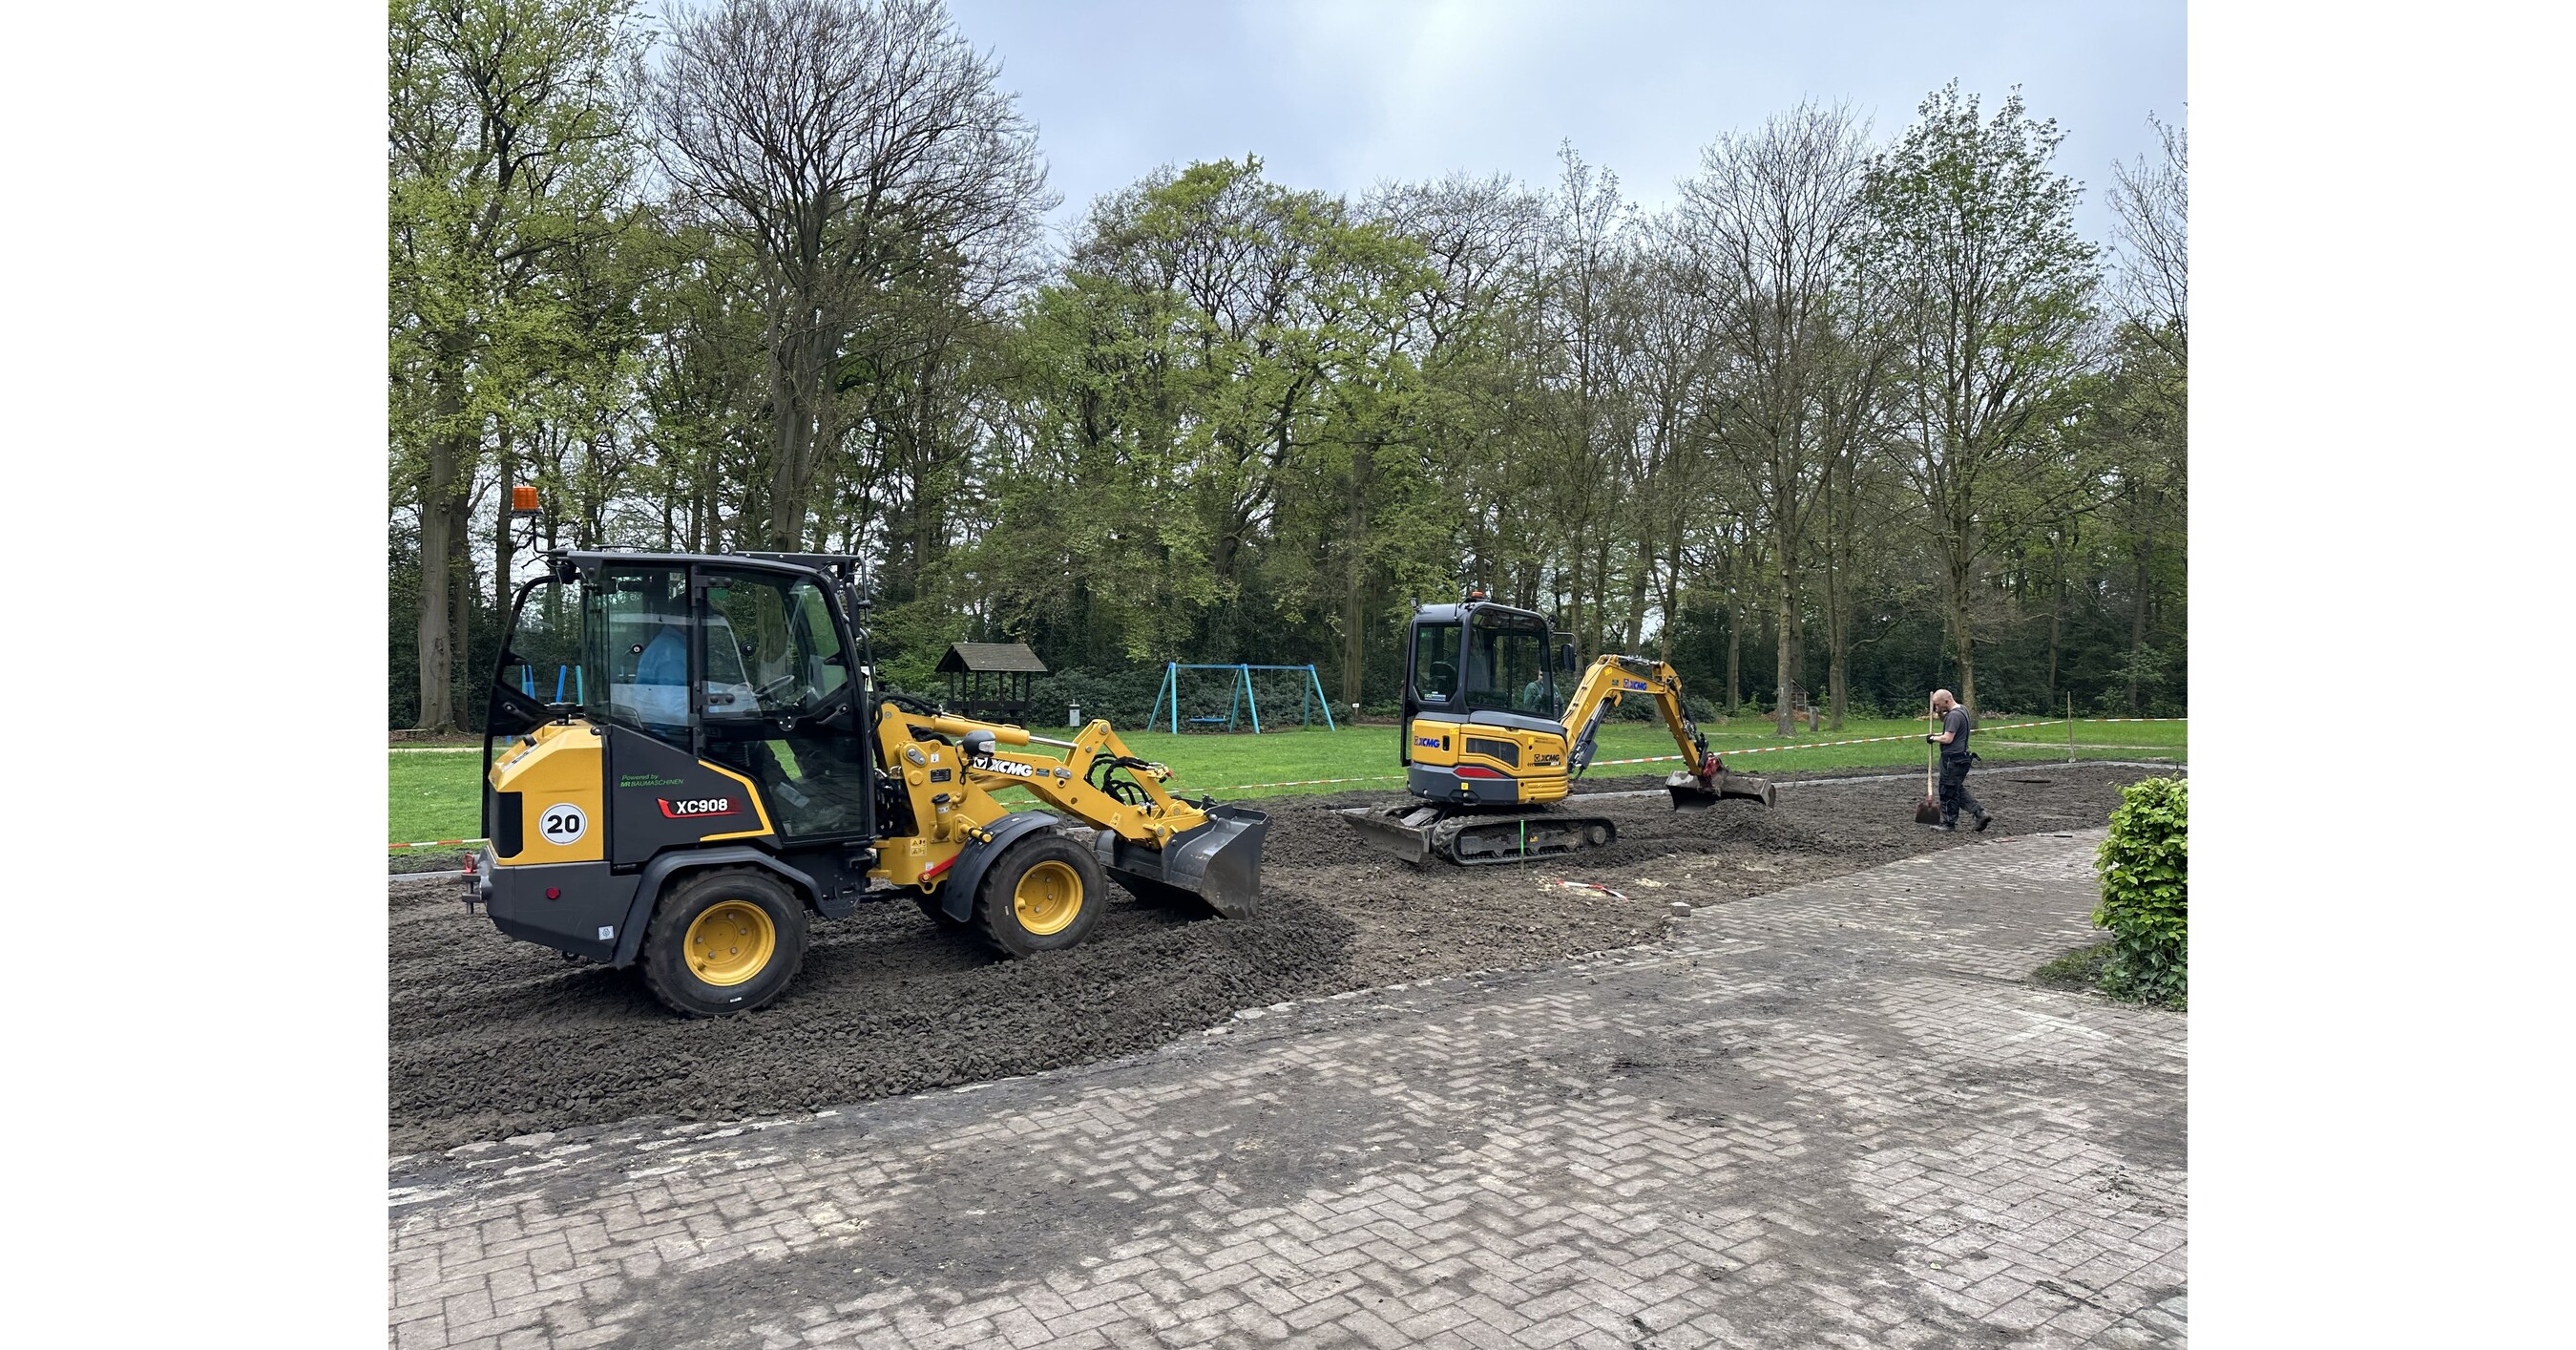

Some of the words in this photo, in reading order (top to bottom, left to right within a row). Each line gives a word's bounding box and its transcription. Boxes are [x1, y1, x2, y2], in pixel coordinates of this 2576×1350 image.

[1628, 680, 1647, 691] XCMG
[1418, 737, 1440, 749] XCMG
[987, 758, 1033, 777] XCMG
[676, 798, 728, 814] XC908
[547, 814, 580, 833] 20
